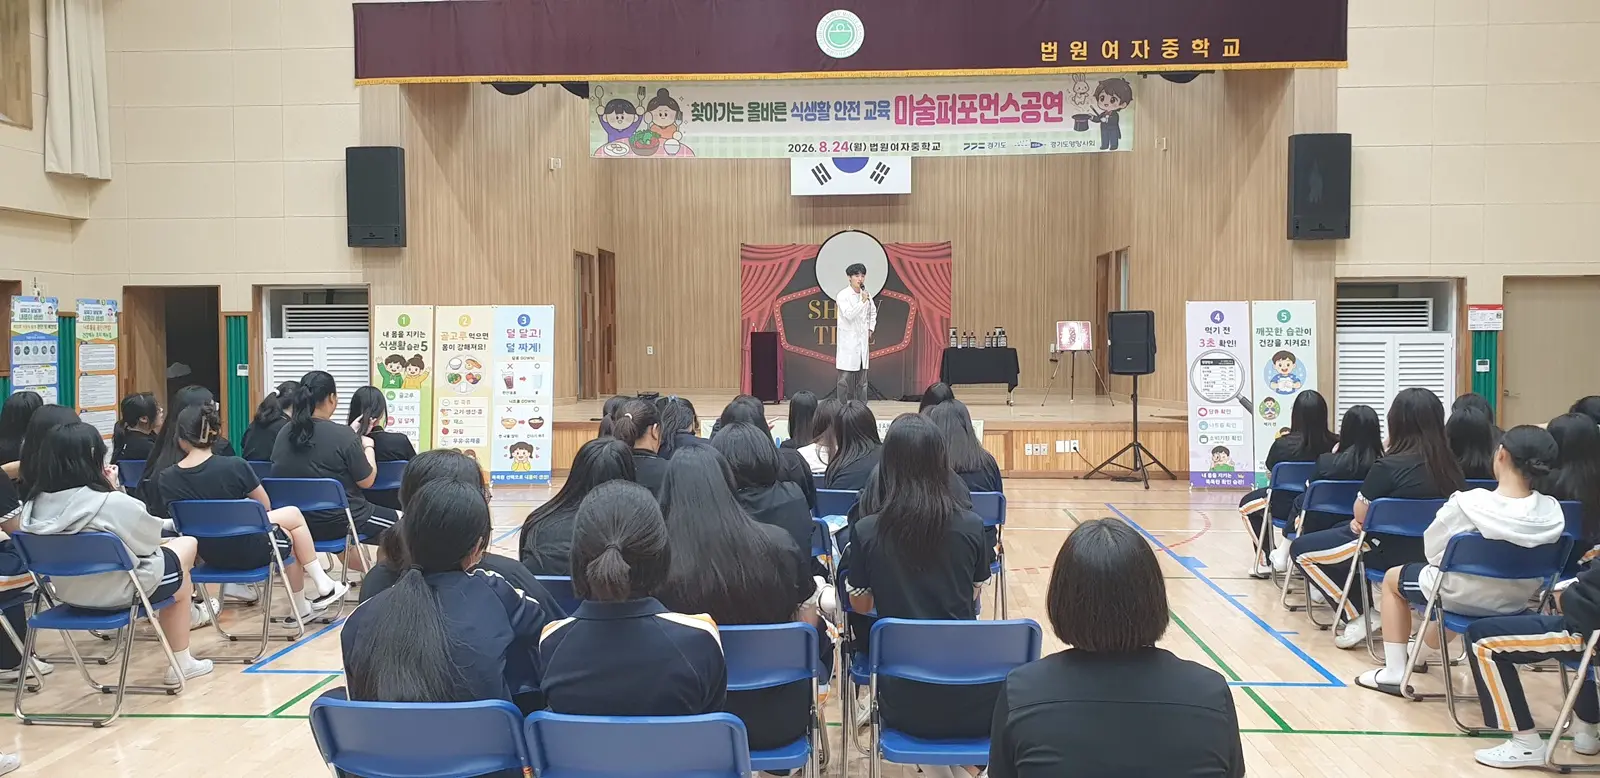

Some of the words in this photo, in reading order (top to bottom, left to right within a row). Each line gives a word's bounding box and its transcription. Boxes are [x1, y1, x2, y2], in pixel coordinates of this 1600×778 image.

[691, 101, 744, 123] 찾아가는
[748, 101, 787, 122] 올바른
[790, 100, 831, 122] 식생활
[833, 100, 861, 121] 안전
[863, 100, 890, 121] 교육
[894, 91, 1064, 126] 미술퍼포먼스공연
[869, 141, 941, 152] 법원여자중학교
[382, 330, 389, 338] 내
[391, 330, 404, 338] 몸을
[406, 330, 426, 338] 지키는
[440, 331, 468, 341] 골고루
[468, 332, 489, 340] 먹으면
[506, 328, 516, 339] 덜
[519, 328, 541, 338] 달고!
[1204, 326, 1220, 335] 먹기
[1223, 326, 1231, 335] 전
[1255, 327, 1283, 337] 깨끗한
[1286, 327, 1312, 337] 습관이
[379, 341, 406, 351] 식생활
[407, 343, 419, 351] 습관
[420, 341, 428, 352] 5
[506, 343, 515, 353] 덜
[518, 342, 541, 353] 짜게!
[1199, 337, 1216, 348] 3초
[1219, 339, 1237, 348] 확인!
[1259, 339, 1281, 348] 건강을
[1284, 339, 1310, 347] 지켜요!
